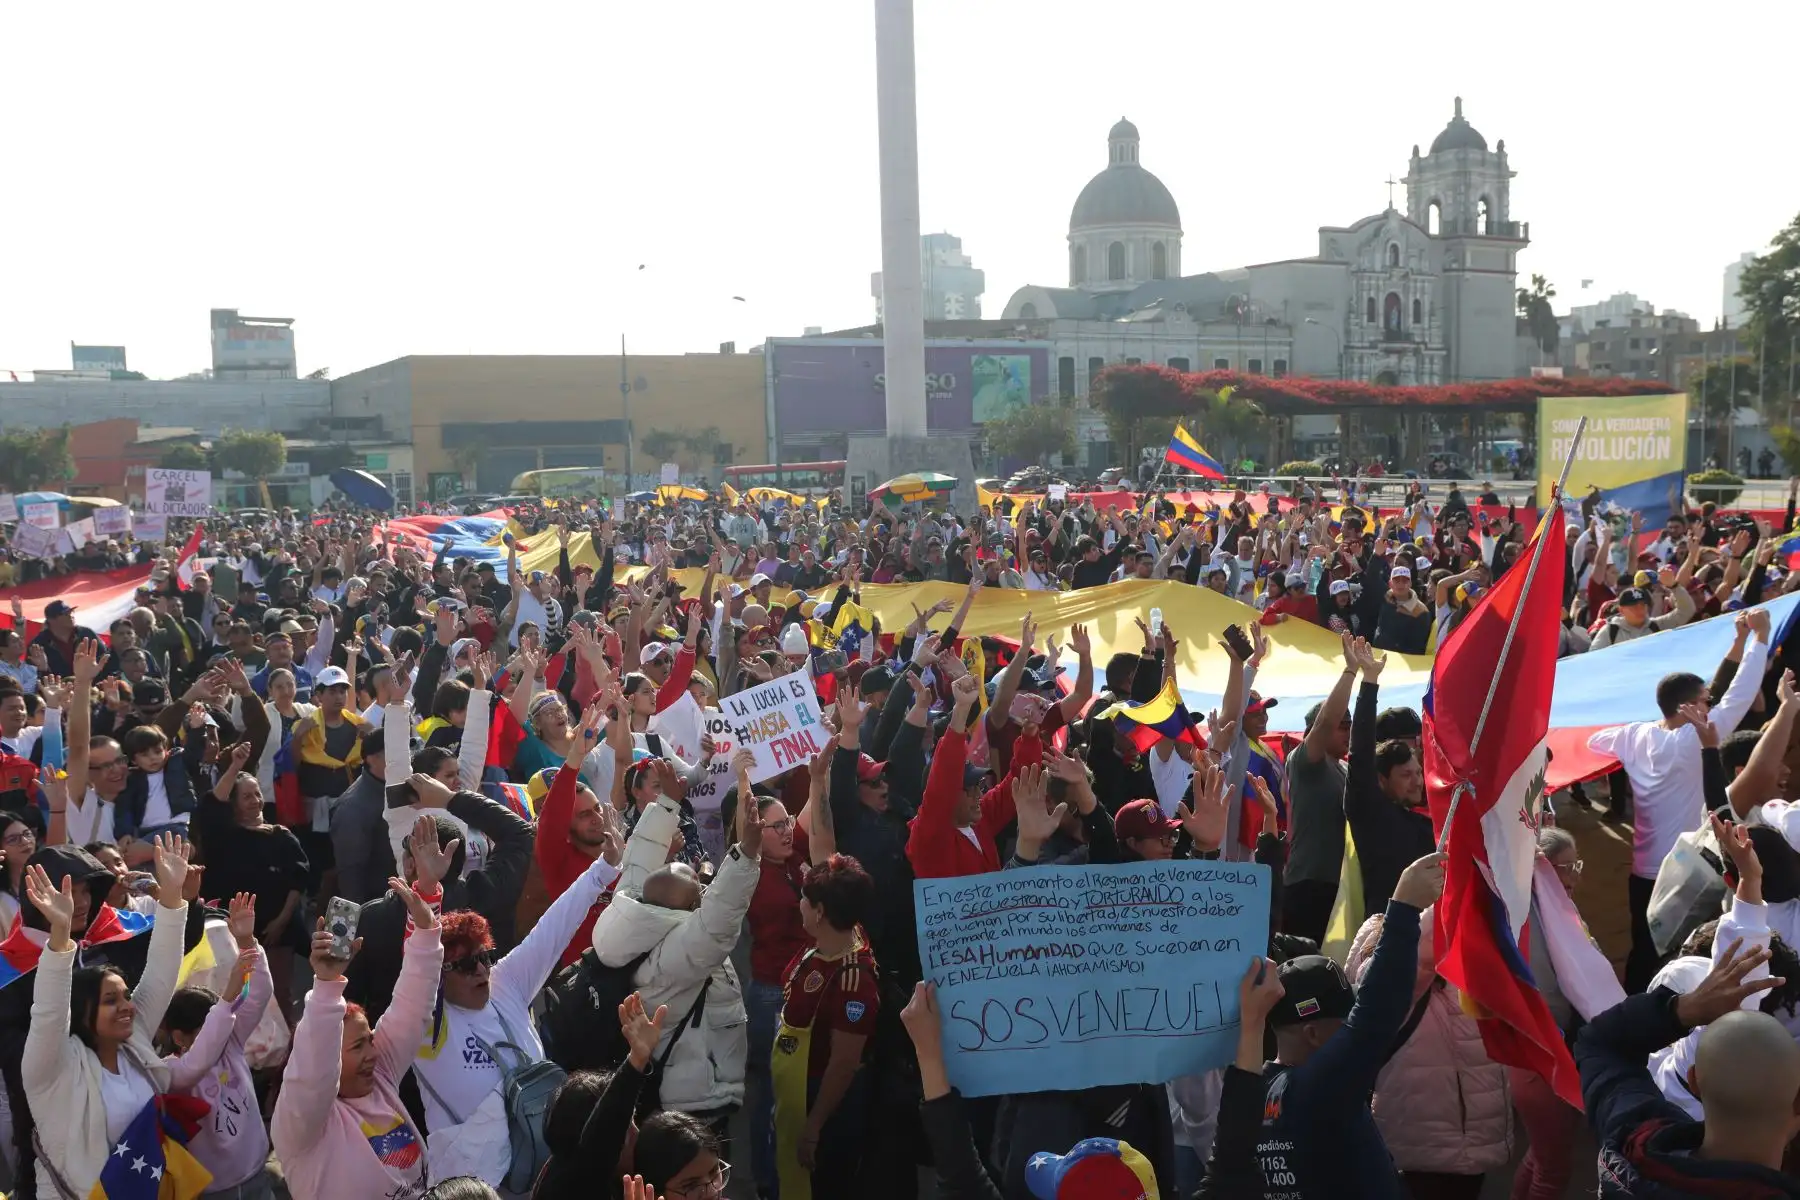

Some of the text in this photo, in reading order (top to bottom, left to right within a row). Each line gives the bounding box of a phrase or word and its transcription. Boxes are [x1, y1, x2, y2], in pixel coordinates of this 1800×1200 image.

[1590, 418, 1603, 432] LA
[1605, 416, 1671, 431] VERDADERA
[147, 502, 208, 516] AL DICTADOR
[730, 680, 806, 717] LA LUCHA ES
[734, 703, 815, 746] #HASTA EL
[769, 729, 821, 768] FINAL
[997, 873, 1073, 892] momento
[1208, 886, 1234, 903] los
[955, 916, 1001, 933] luchan
[1007, 911, 1032, 929] por
[1017, 924, 1063, 936] mundo
[1066, 926, 1087, 937] los
[1160, 920, 1181, 935] de
[928, 946, 978, 970] LESA
[950, 980, 1242, 1051] SOS VENEZUEL
